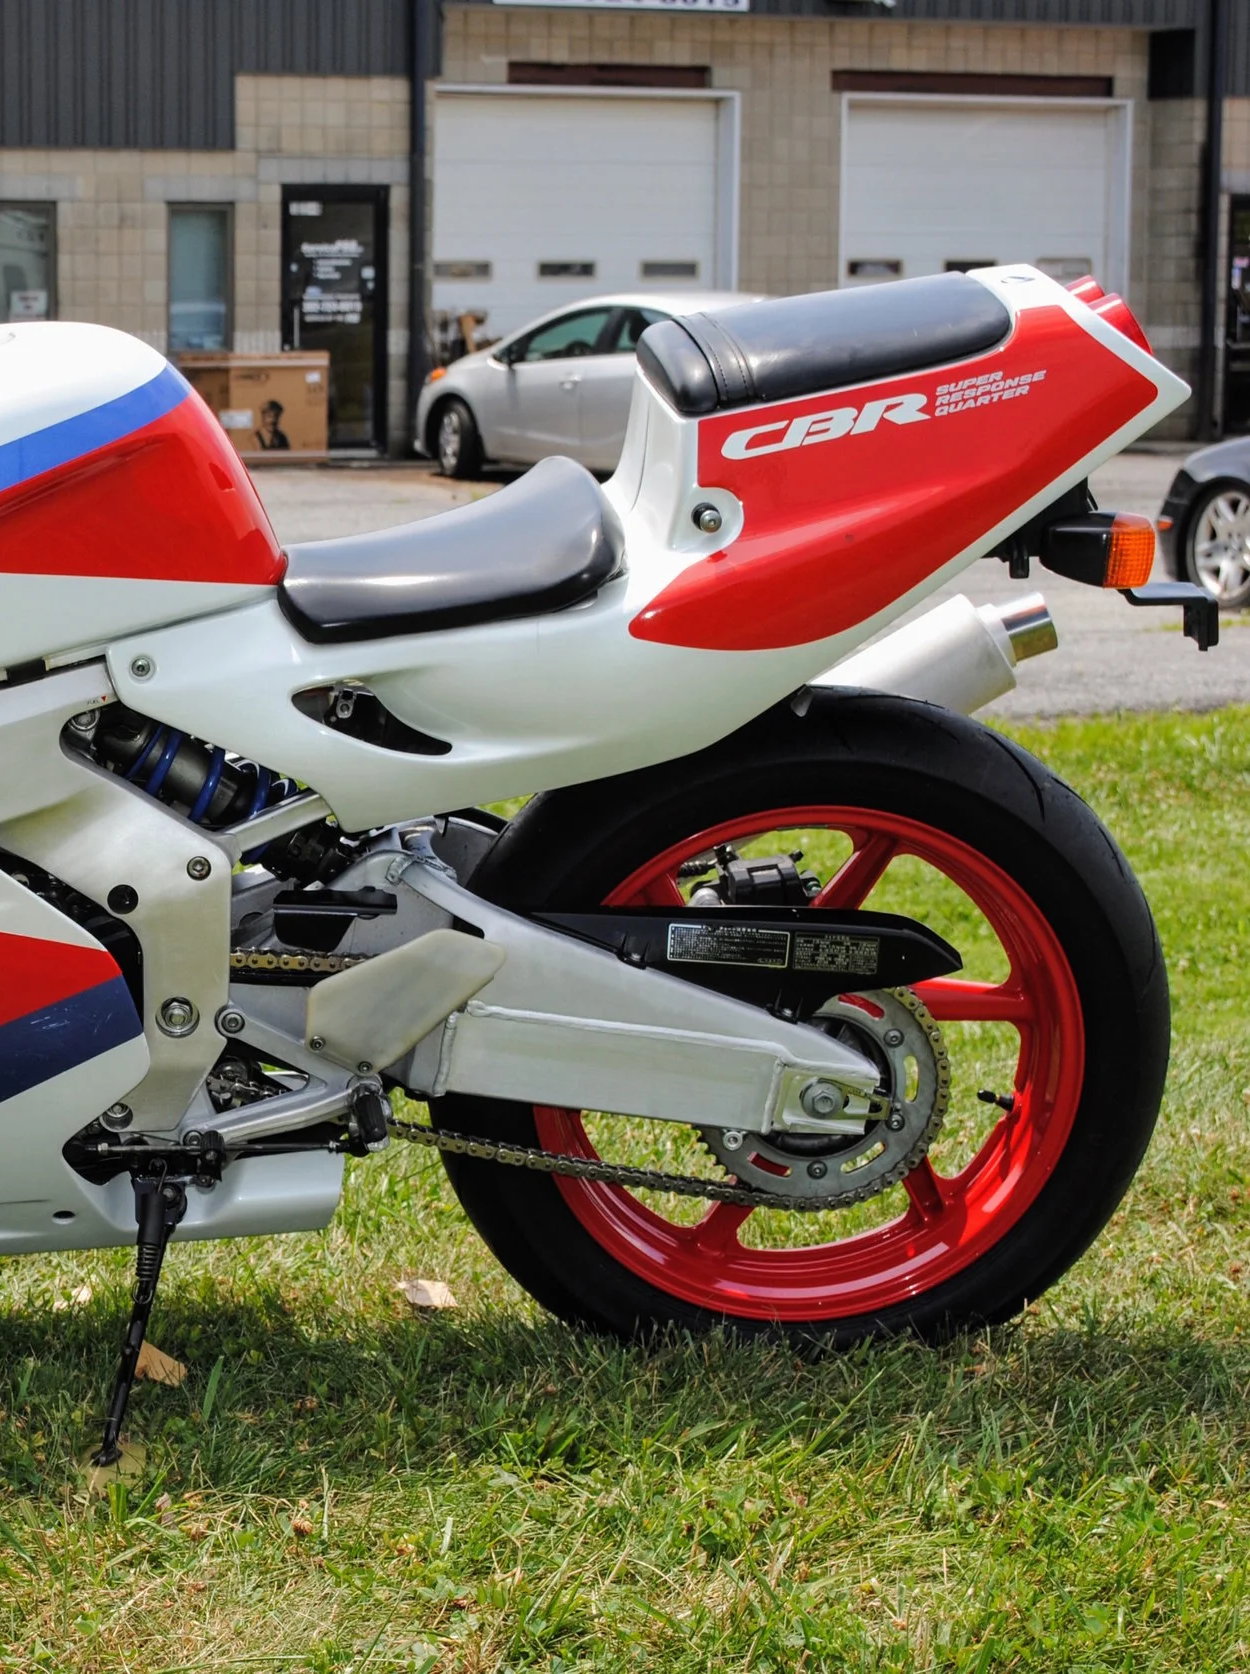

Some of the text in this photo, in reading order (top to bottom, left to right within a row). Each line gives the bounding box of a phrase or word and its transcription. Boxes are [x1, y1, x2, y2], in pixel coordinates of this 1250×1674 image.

[935, 370, 1004, 396] SUPER
[935, 369, 1047, 407] RESPONSE
[934, 385, 1030, 417] QUARTER
[720, 392, 932, 461] CBR
